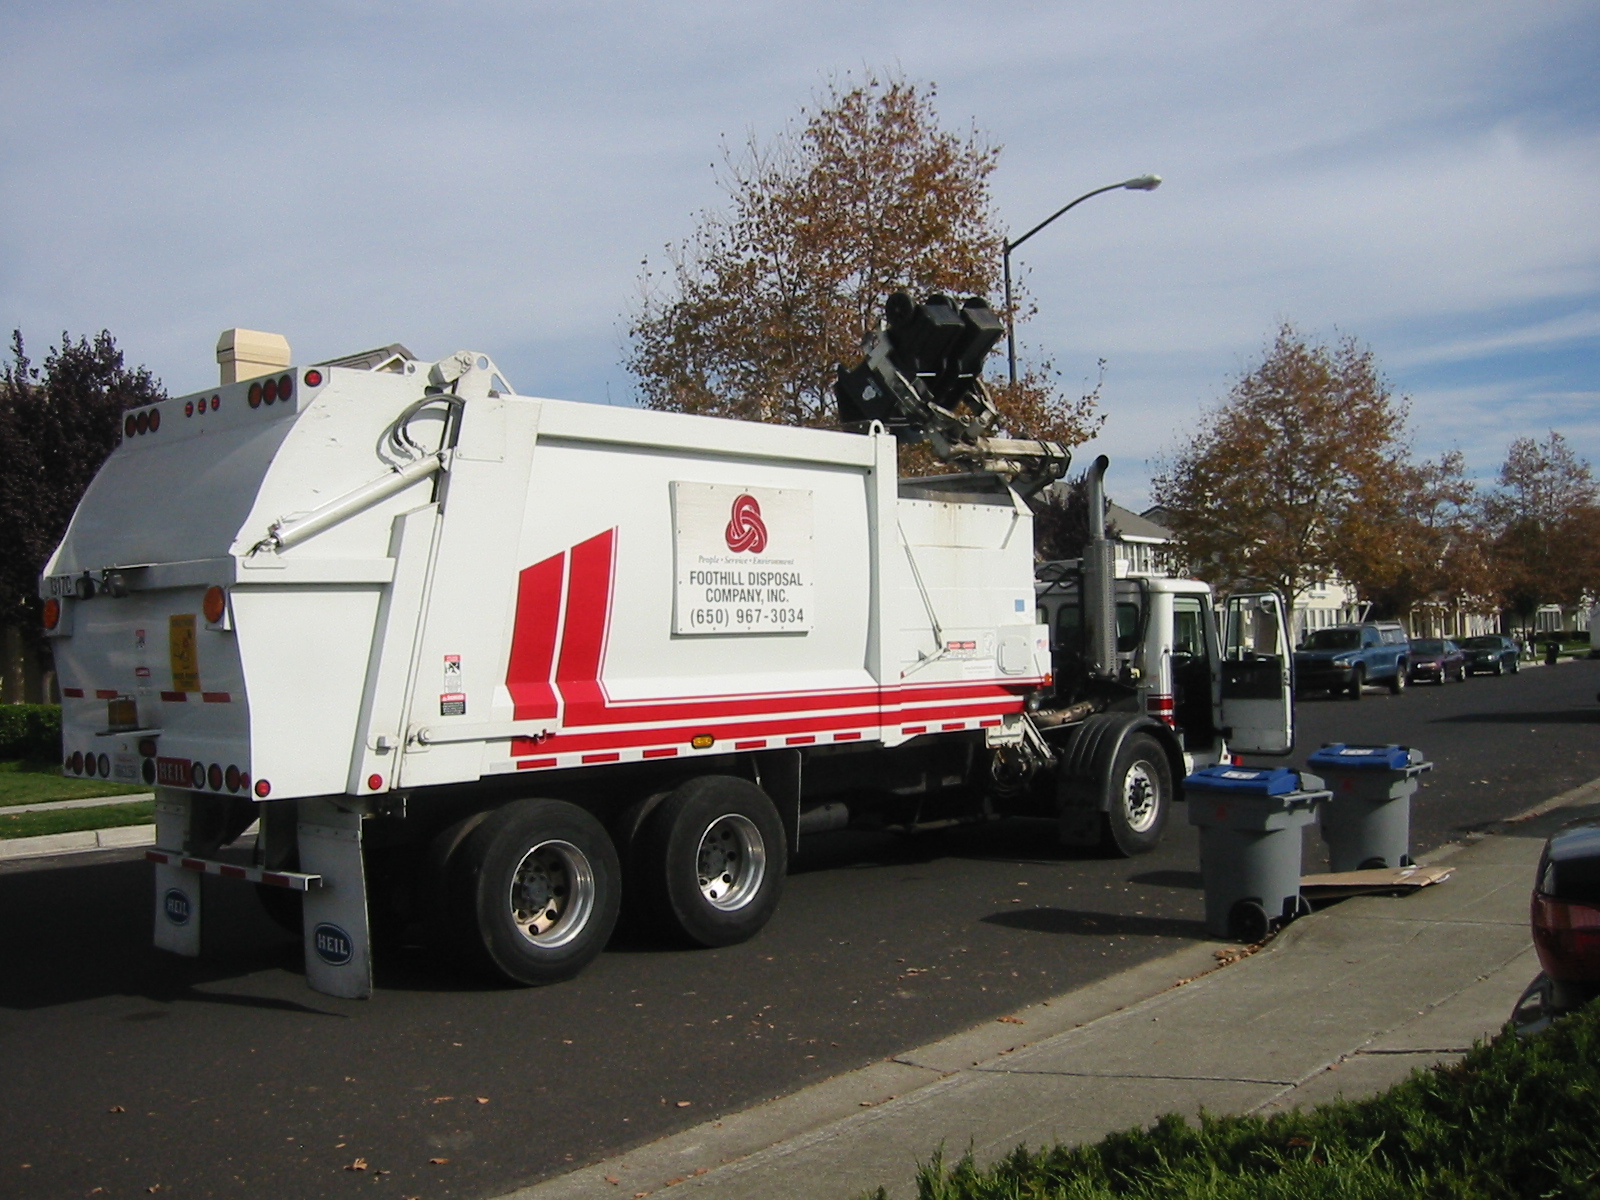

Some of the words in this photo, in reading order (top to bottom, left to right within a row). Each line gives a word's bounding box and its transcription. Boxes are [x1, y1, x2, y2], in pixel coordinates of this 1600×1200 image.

[698, 555, 719, 564] People
[724, 556, 748, 564] Service
[753, 557, 794, 565] Environment
[690, 571, 744, 586] FOOTHILL
[748, 572, 803, 586] DISPOSAL
[706, 588, 764, 605] COMPANY,
[767, 589, 789, 602] INC.
[690, 608, 730, 627] (650)
[736, 608, 804, 624] 967-3034
[159, 763, 187, 783] HEIL
[167, 898, 189, 916] HEIL
[317, 934, 348, 955] HEIL
